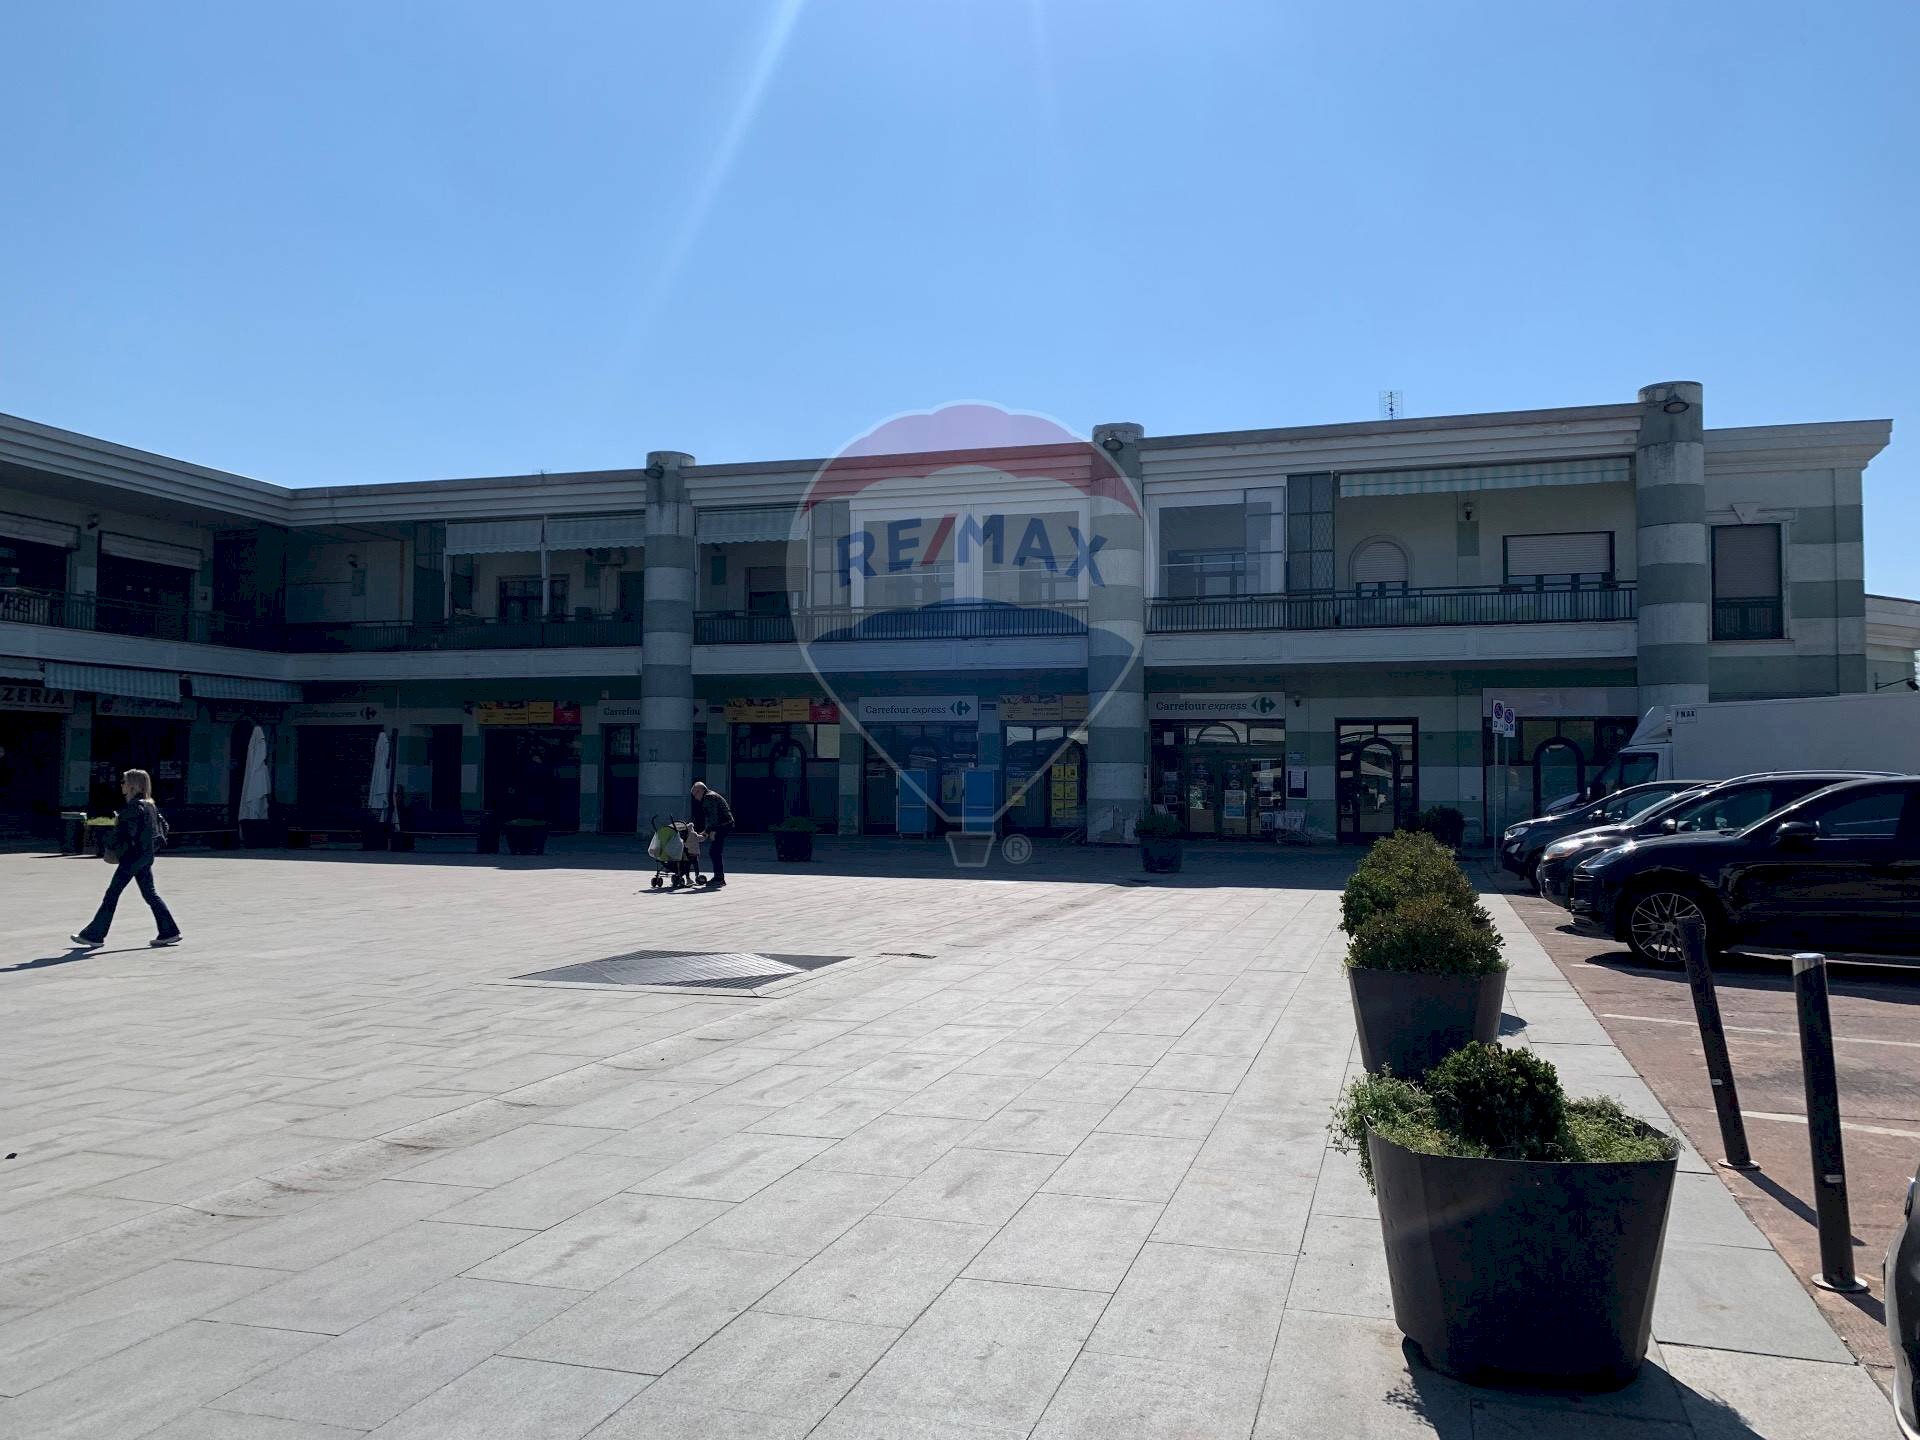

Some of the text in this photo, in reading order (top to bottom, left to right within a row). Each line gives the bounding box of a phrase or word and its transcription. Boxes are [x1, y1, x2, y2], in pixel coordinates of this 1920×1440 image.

[603, 706, 640, 717] Carrefou
[864, 704, 947, 716] Carrefour express
[1156, 701, 1248, 712] Carrefour express
